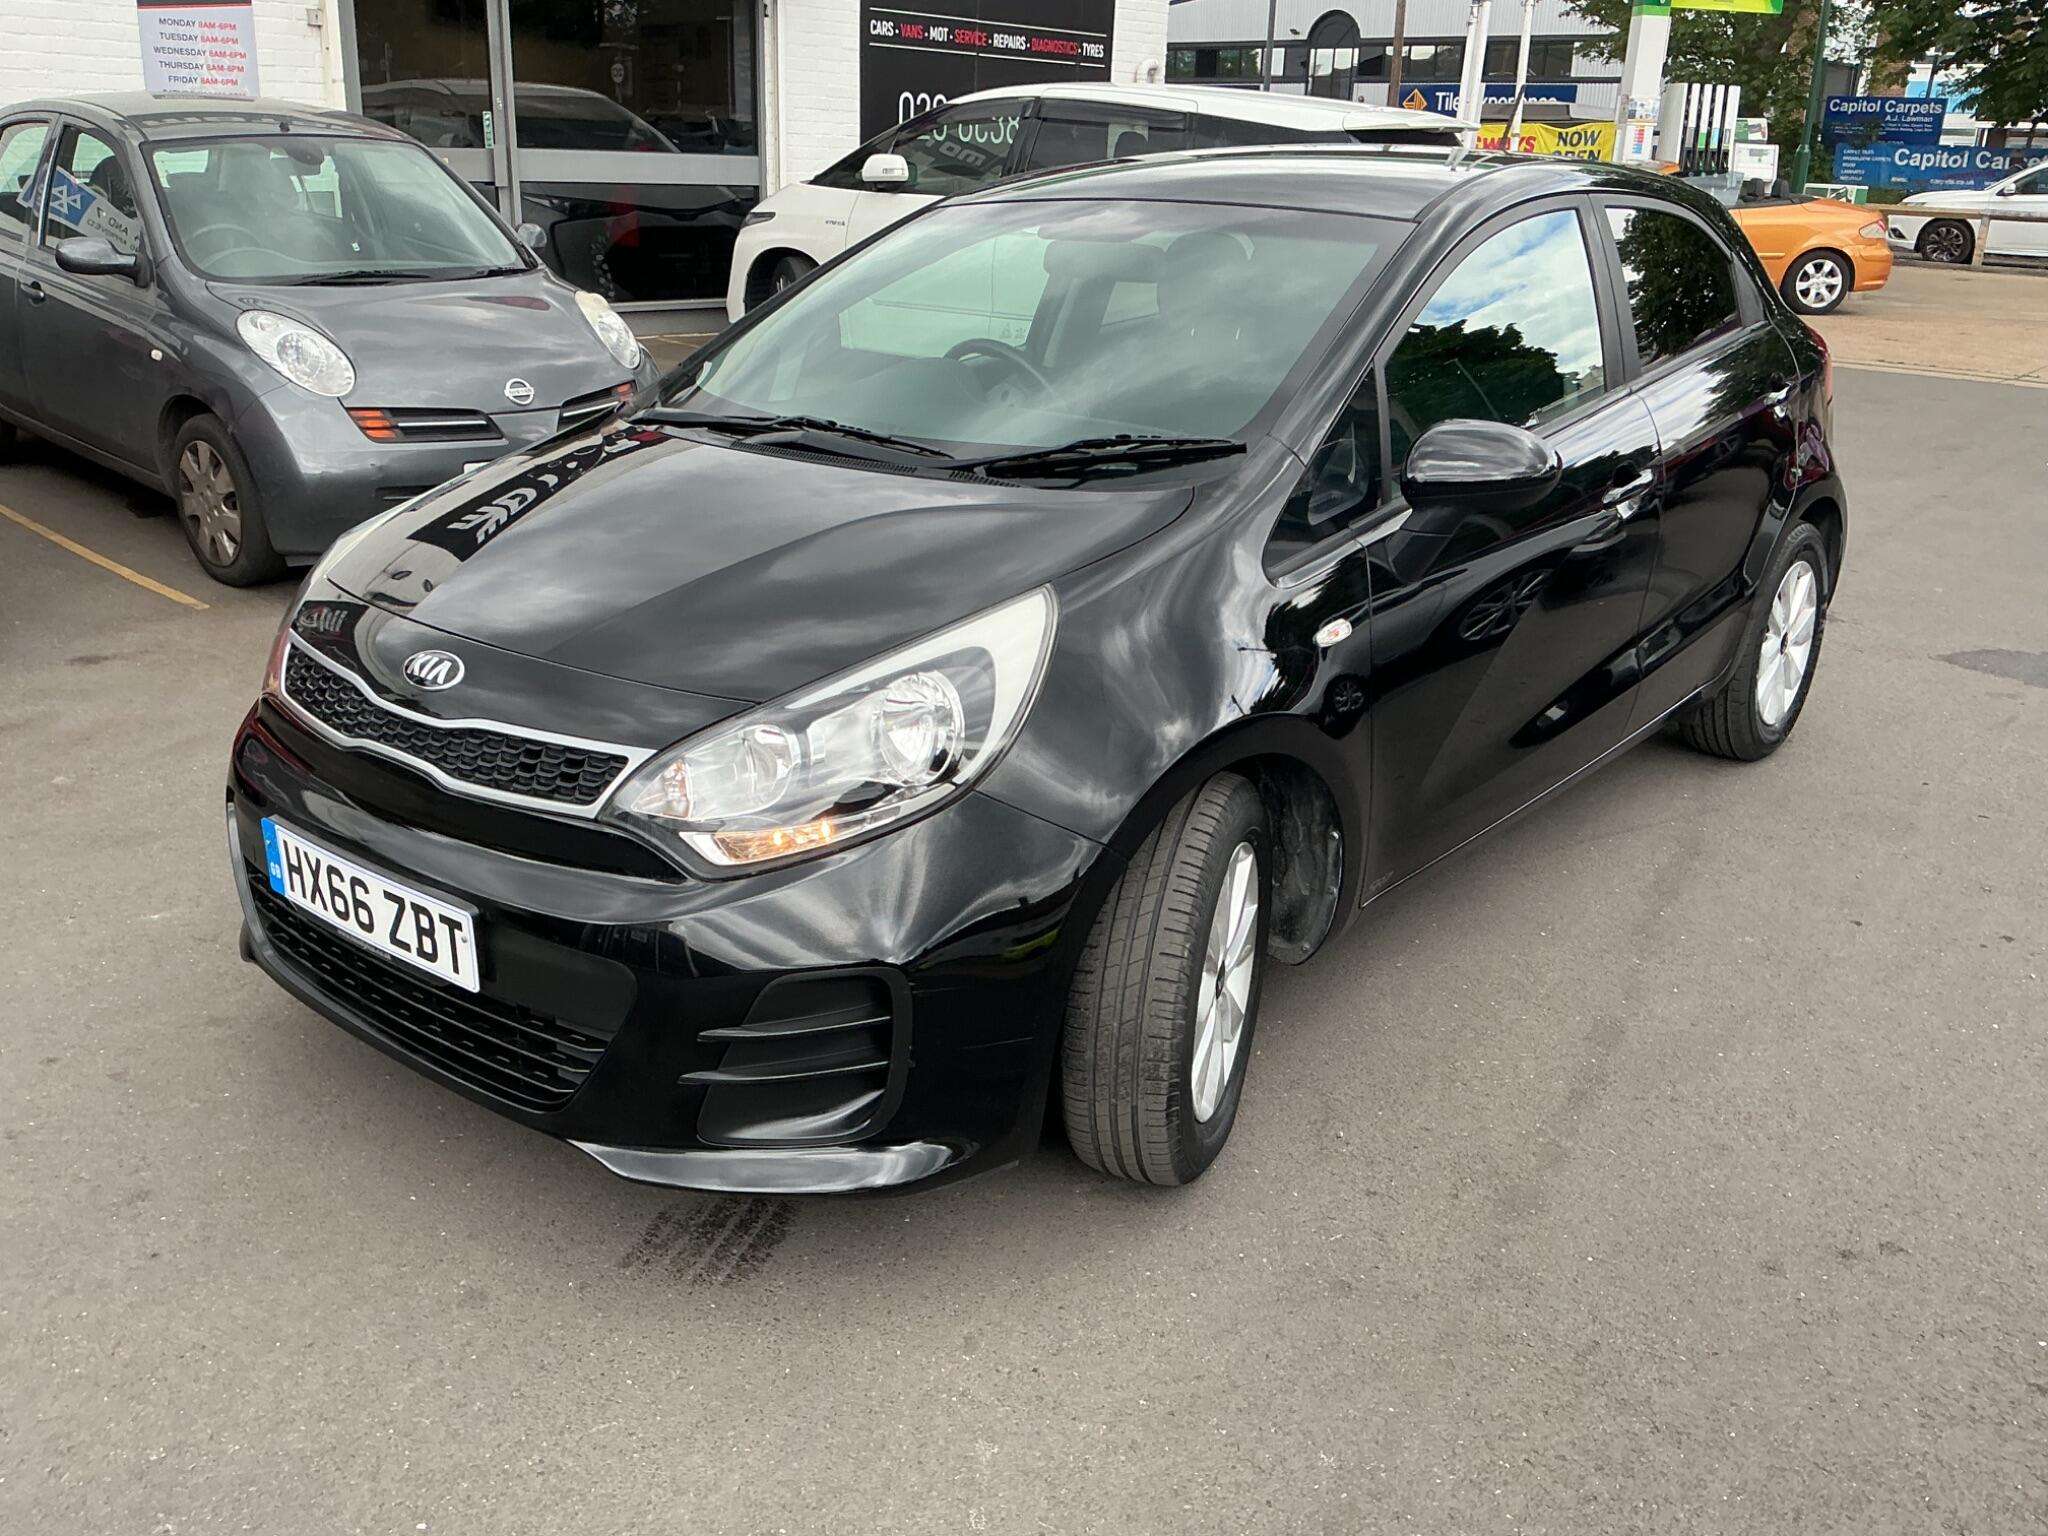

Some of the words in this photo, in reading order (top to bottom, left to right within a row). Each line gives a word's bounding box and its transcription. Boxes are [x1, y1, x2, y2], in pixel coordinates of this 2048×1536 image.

[158, 17, 196, 28] MONDAY
[159, 31, 199, 42] TUESDAY
[870, 19, 894, 36] CARS
[900, 23, 924, 40] VANS
[929, 26, 948, 41] MOT
[954, 28, 987, 46] SERVICE
[993, 33, 1026, 50] REPAIRS
[1031, 37, 1078, 55] DIAGNOSTICS
[1082, 42, 1104, 58] TYRES
[152, 45, 207, 57] WEDNESDAY
[158, 60, 204, 71] THURSDAY
[168, 75, 198, 85] FRIDAY
[1435, 92, 1460, 111] Tile
[1829, 99, 1881, 114] Capitol
[1885, 100, 1942, 116] Carpets
[1556, 130, 1602, 147] NOW
[1894, 148, 1969, 171] Capitol
[1976, 150, 2048, 170] Care
[407, 653, 452, 684] KIA
[269, 861, 281, 879] GB
[283, 839, 374, 934] HX66
[383, 889, 463, 975] ZBT
